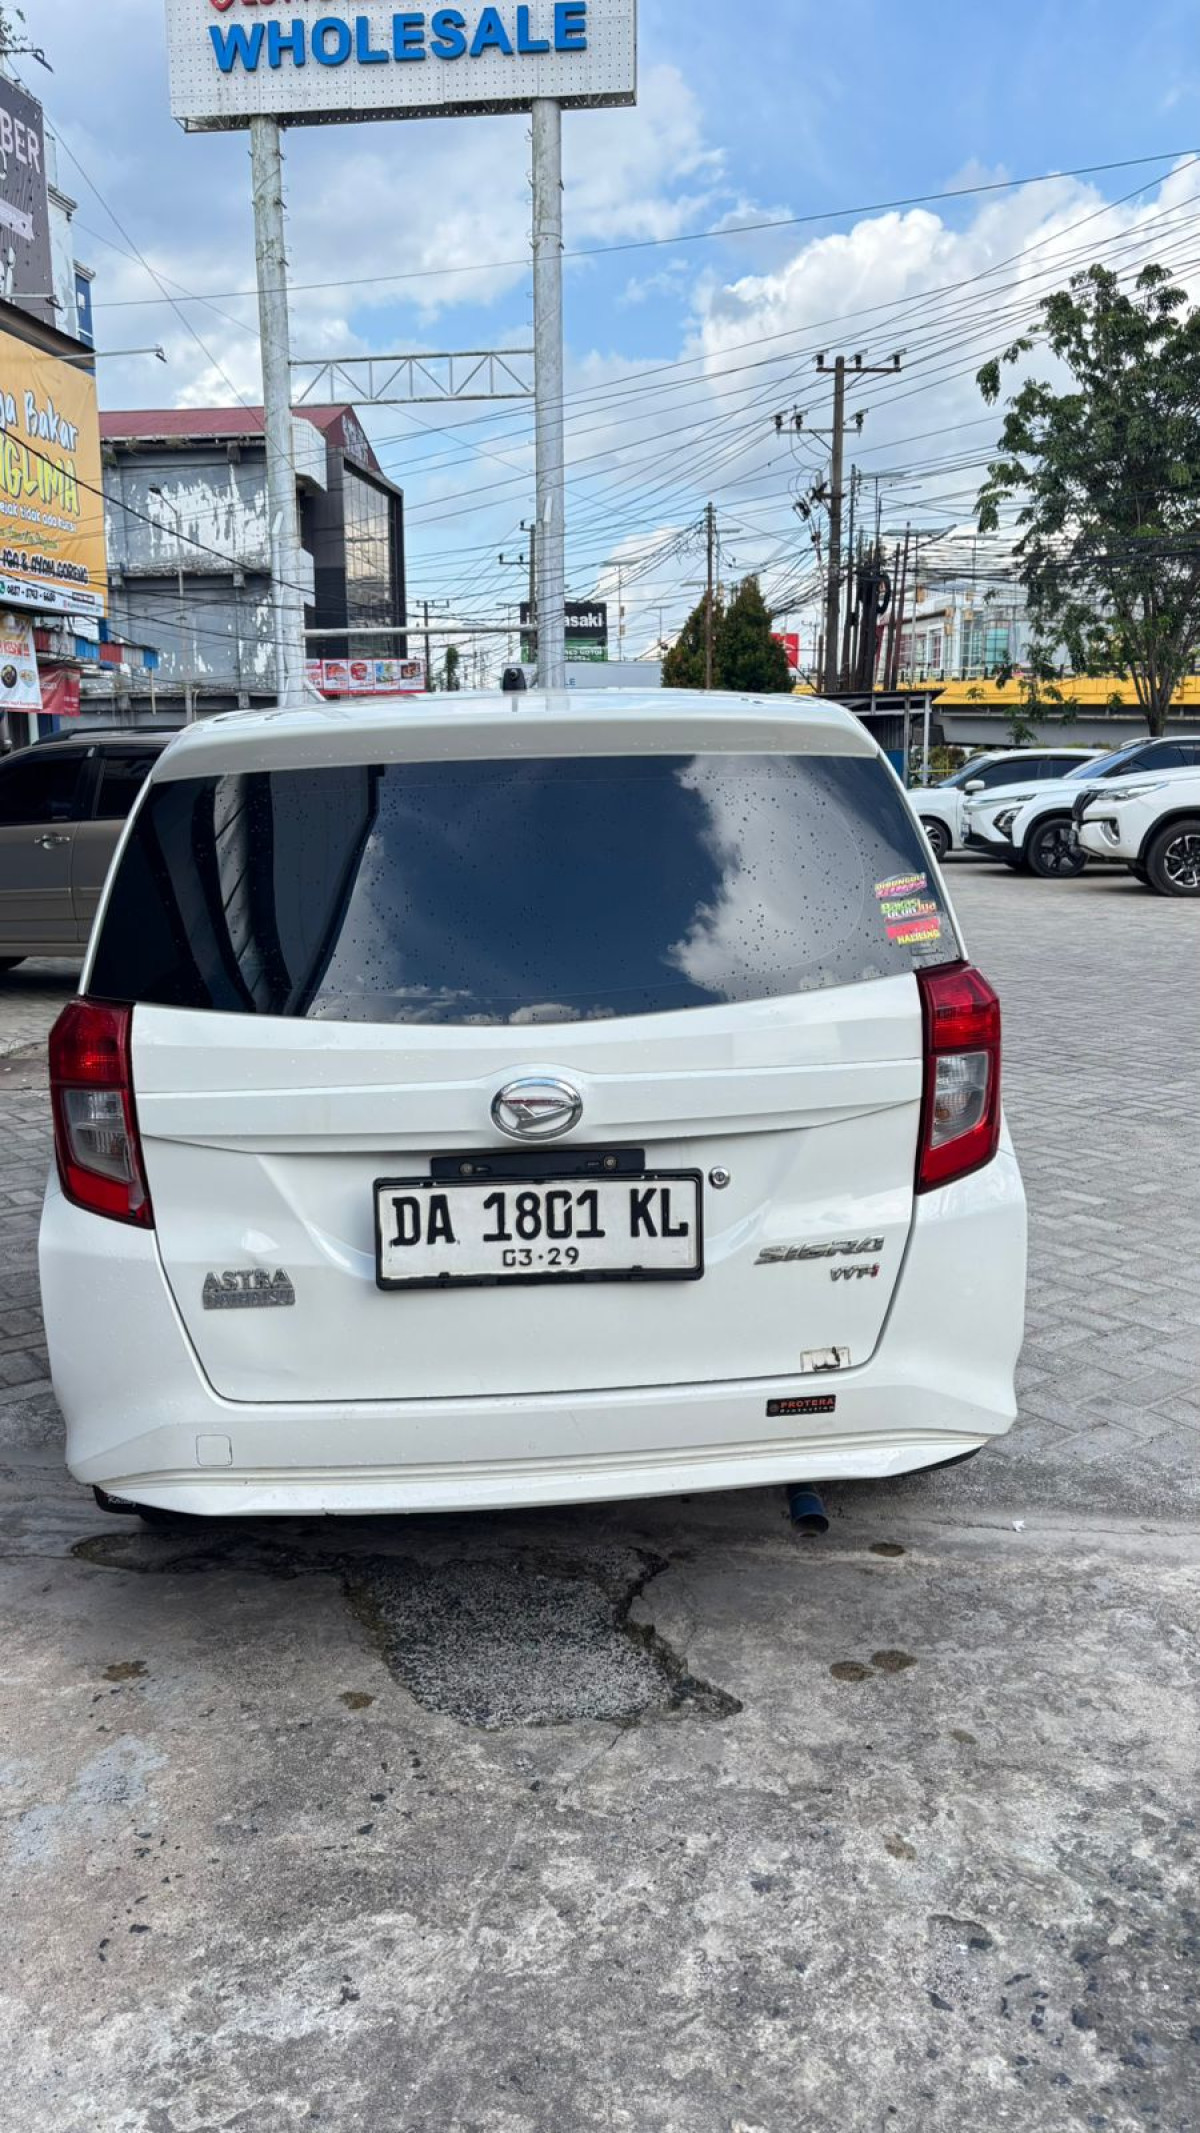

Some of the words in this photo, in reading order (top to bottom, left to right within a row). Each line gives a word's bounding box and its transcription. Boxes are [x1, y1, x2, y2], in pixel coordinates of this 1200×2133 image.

[208, 1, 587, 72] WHOLESALE
[24, 389, 79, 452] Bakar
[390, 1194, 457, 1247] DA
[482, 1189, 606, 1241] 1801
[629, 1188, 689, 1238] KL
[753, 1236, 885, 1266] SIGRA
[203, 1267, 294, 1290] ASTRA
[780, 1398, 834, 1409] PROTERA
